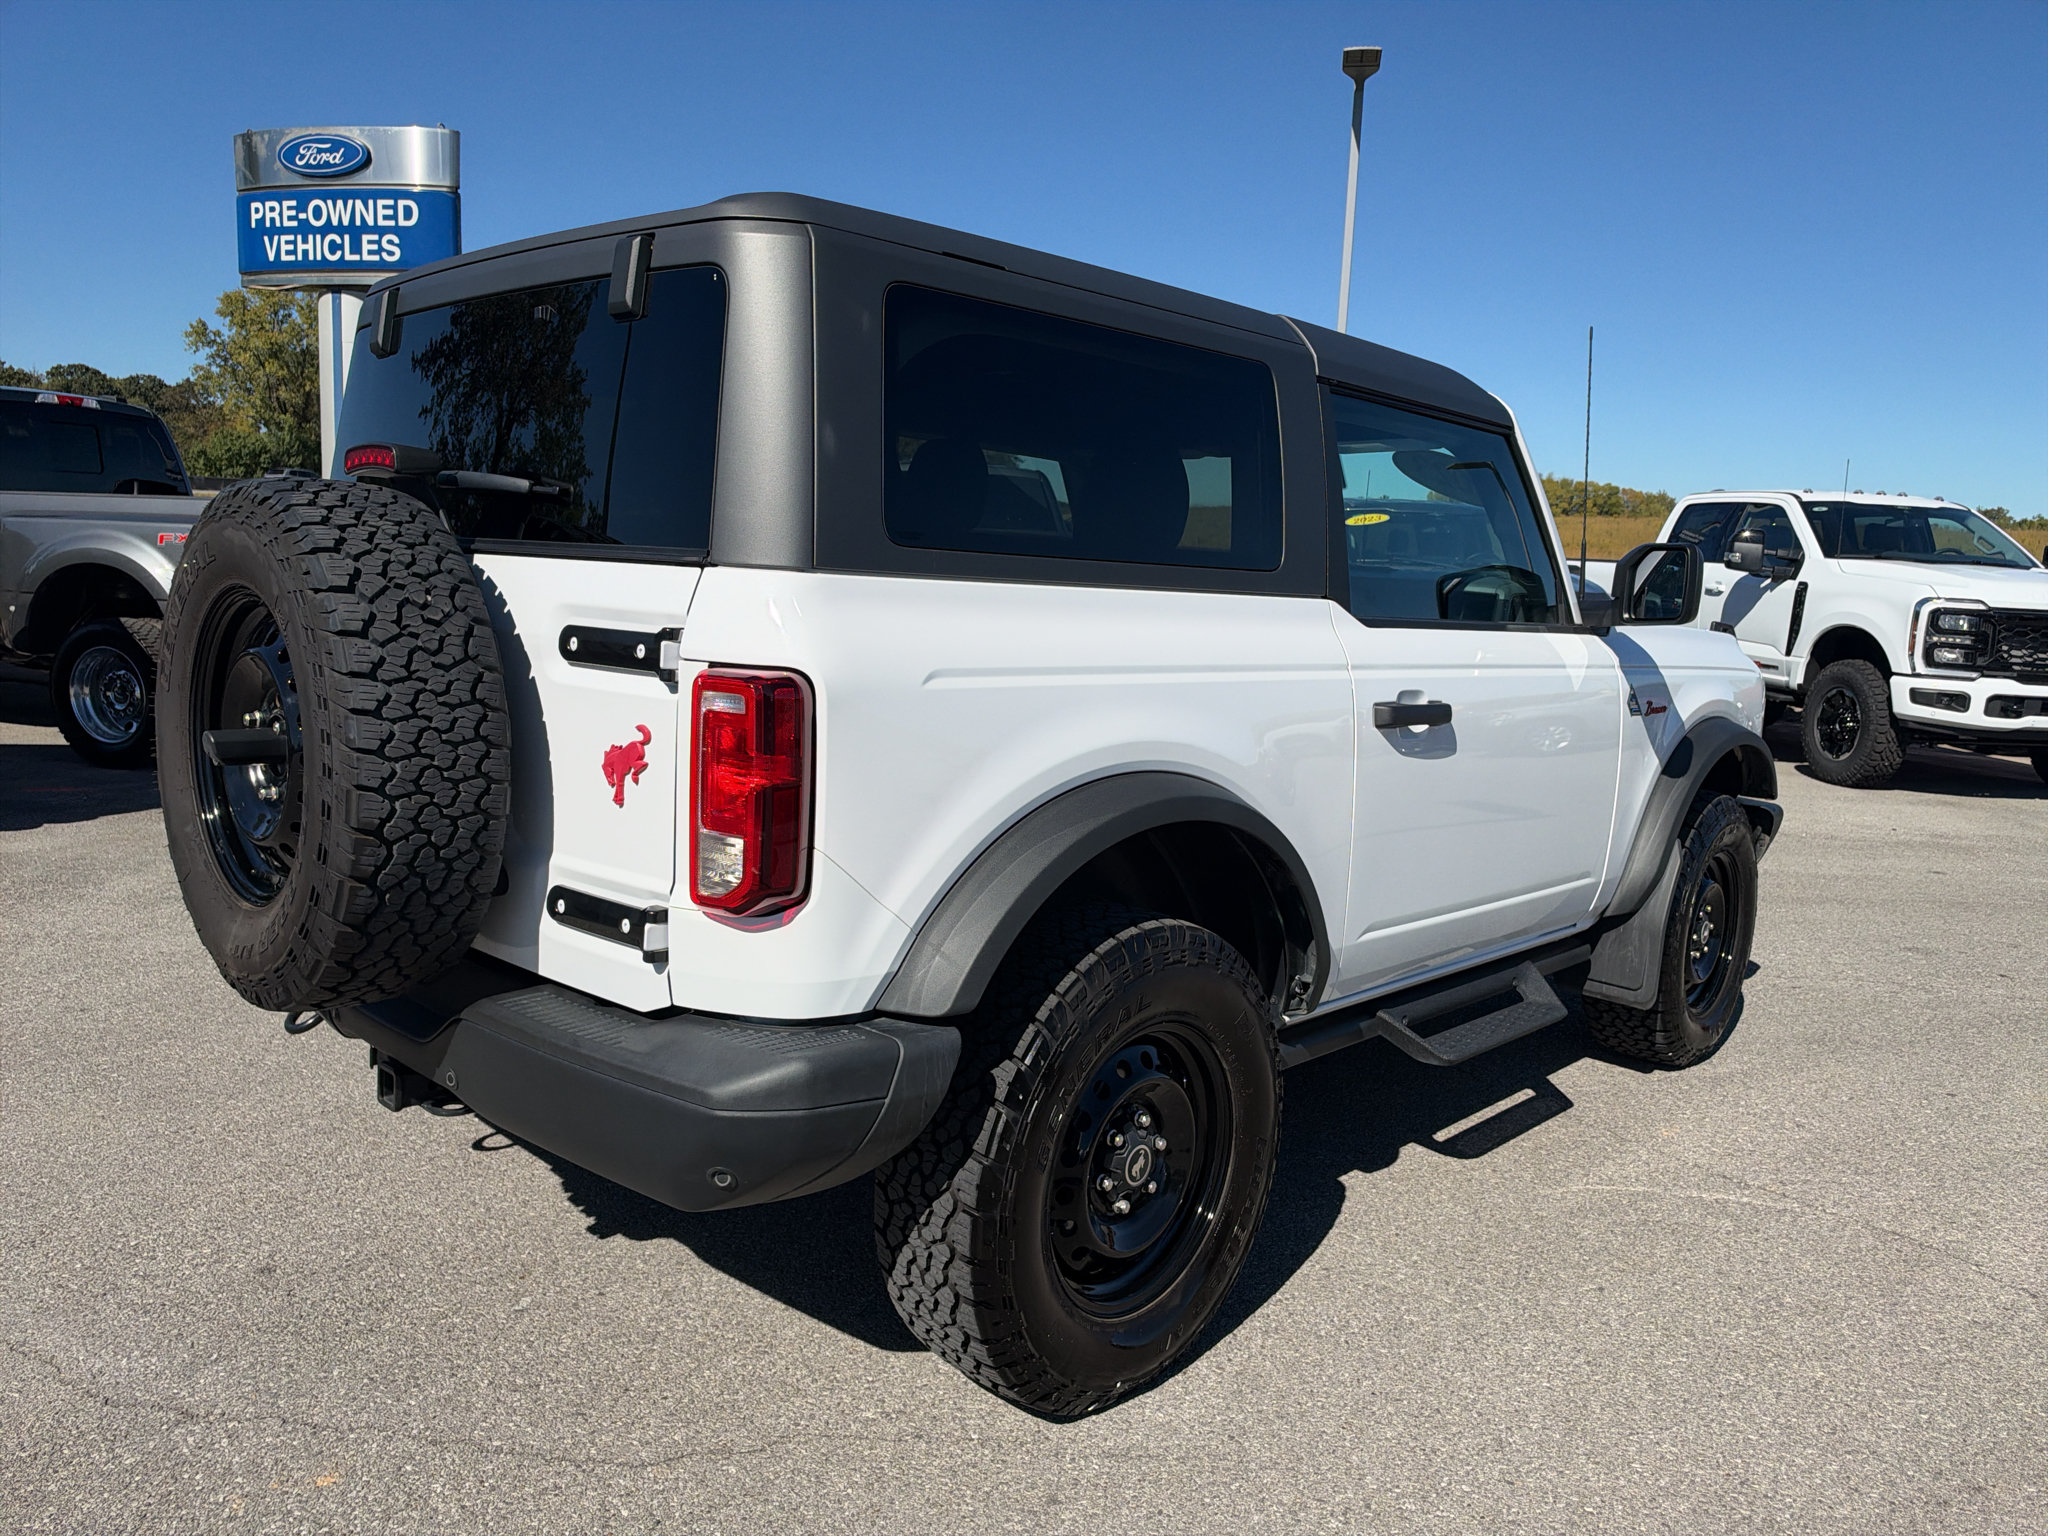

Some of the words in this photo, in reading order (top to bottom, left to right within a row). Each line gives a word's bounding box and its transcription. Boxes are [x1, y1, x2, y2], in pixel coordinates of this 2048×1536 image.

[295, 143, 345, 165] Ford
[250, 199, 419, 228] PRE-OWNED
[263, 233, 401, 262] VEHICLES
[1036, 994, 1151, 1173] GENERAL
